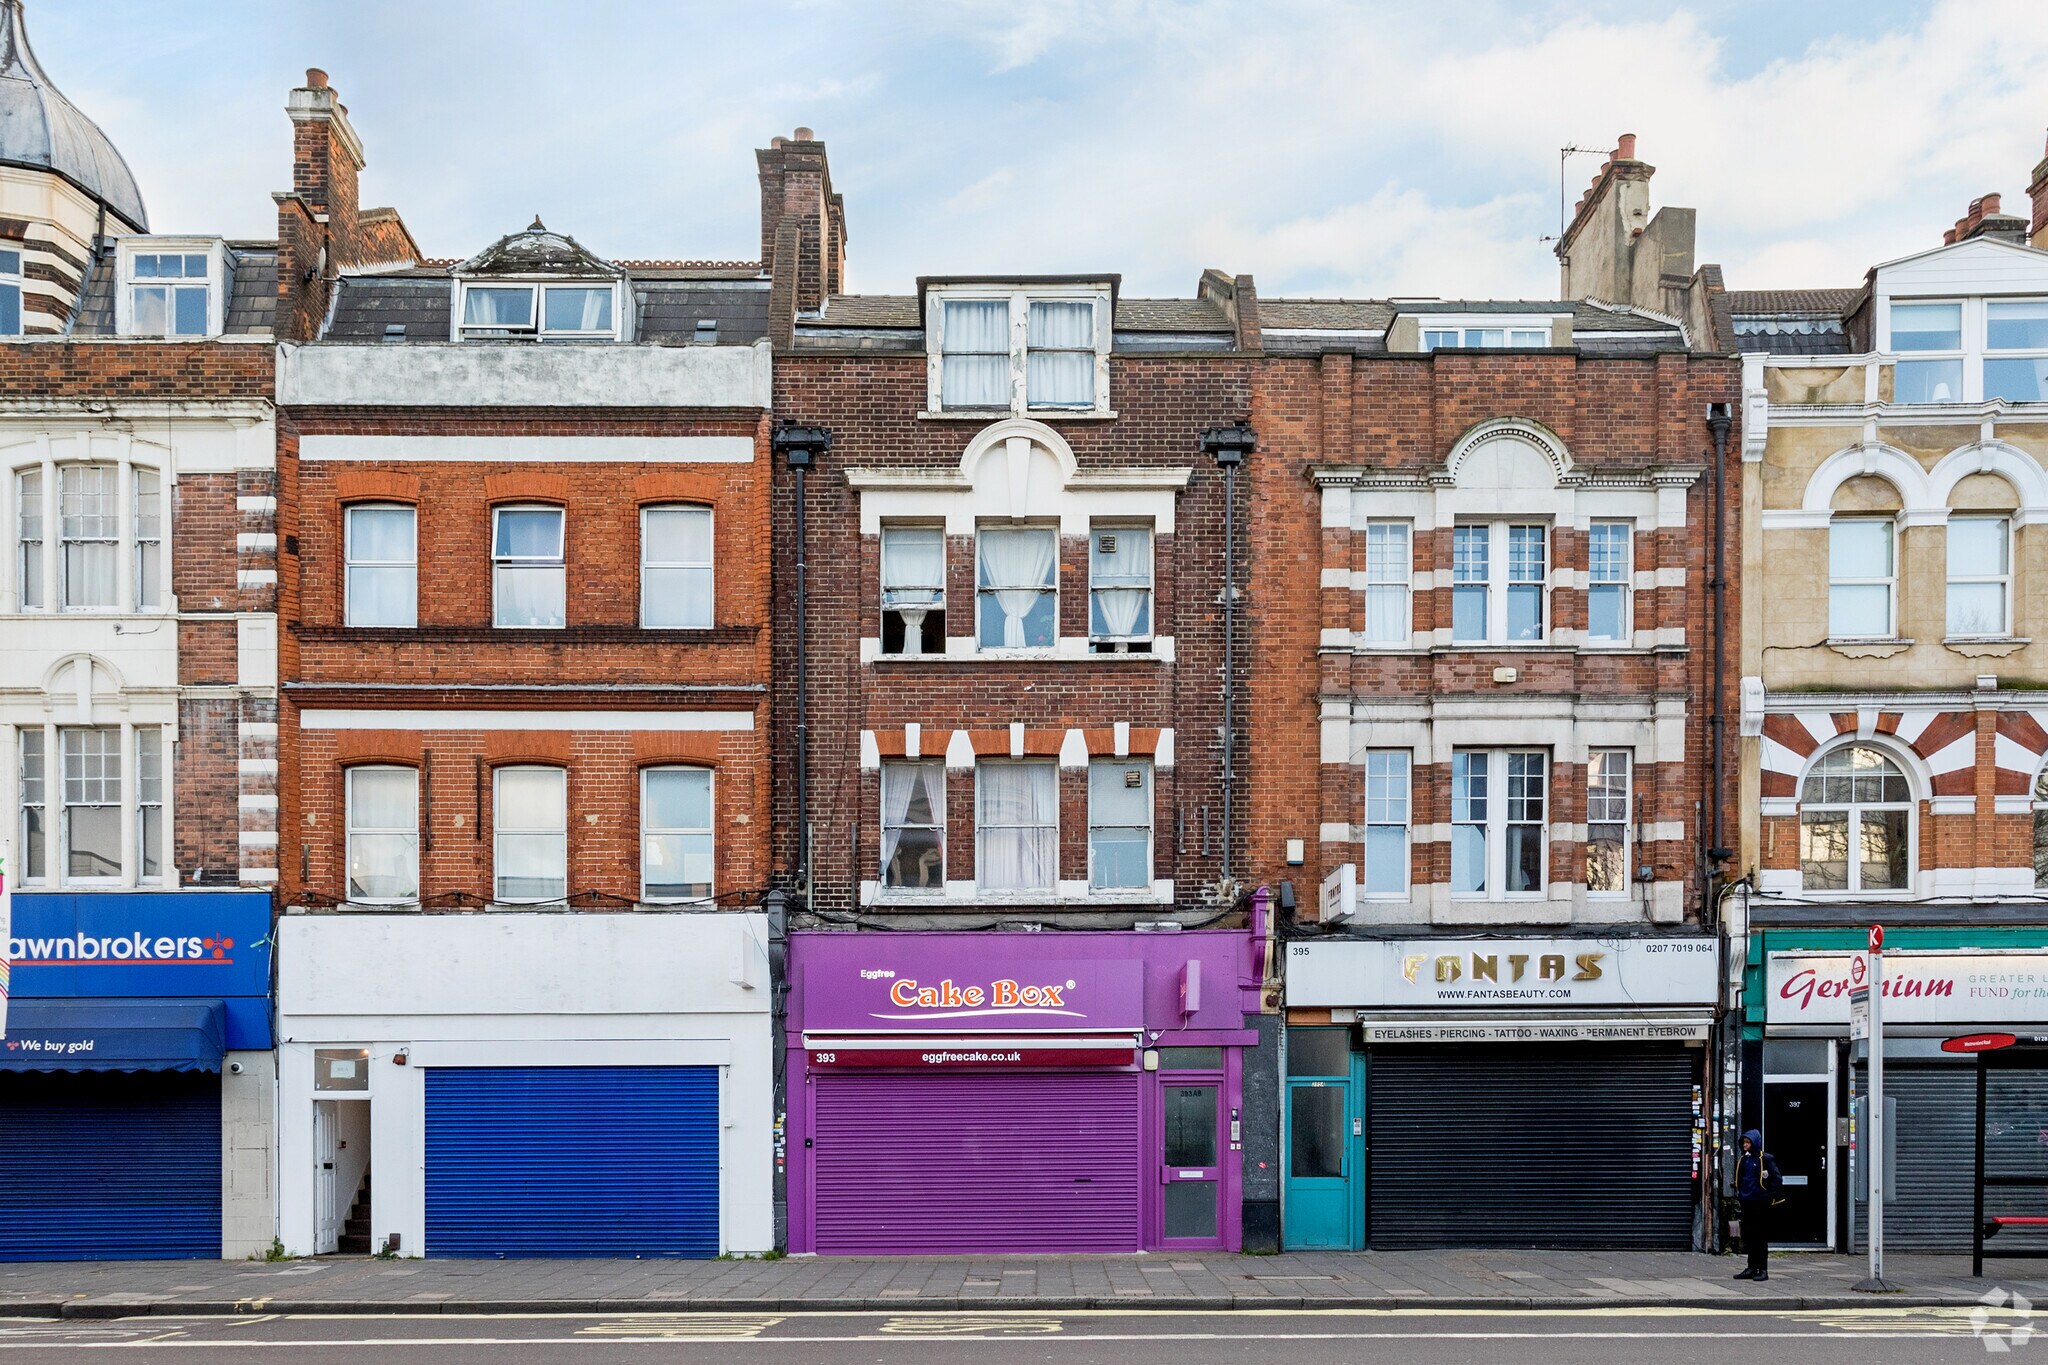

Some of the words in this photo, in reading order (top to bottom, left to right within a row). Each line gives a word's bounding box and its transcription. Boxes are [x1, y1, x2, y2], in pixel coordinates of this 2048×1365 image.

[1869, 927, 1879, 947] K
[1292, 946, 1310, 956] 395
[1646, 944, 1668, 953] 0207
[1671, 944, 1693, 953] 7019
[1695, 944, 1713, 953] 064
[1404, 952, 1606, 984] FANTAS
[860, 969, 896, 980] Eggfree
[1968, 974, 2035, 983] GREATER
[890, 979, 985, 1008] Cake
[991, 979, 1065, 1008] Box
[1437, 989, 1571, 999] WWW.FANTASBEAUTY.COM
[1780, 969, 1953, 1010] Gerium
[1970, 986, 2009, 998] FUND
[2010, 987, 2031, 1000] for
[2033, 987, 2048, 998] th
[1374, 1029, 1432, 1039] EYELASHES
[1440, 1029, 1486, 1038] PIERCING
[1494, 1029, 1532, 1038] TATTOO
[1539, 1028, 1578, 1038] WAXING
[1586, 1028, 1645, 1037] PERMANENT
[1647, 1027, 1697, 1037] EYEBROW
[20, 1040, 41, 1051] We
[44, 1040, 66, 1053] buy
[68, 1040, 94, 1053] gold
[816, 1053, 836, 1063] 393
[922, 1052, 1021, 1063] eggfreecake.co.uk
